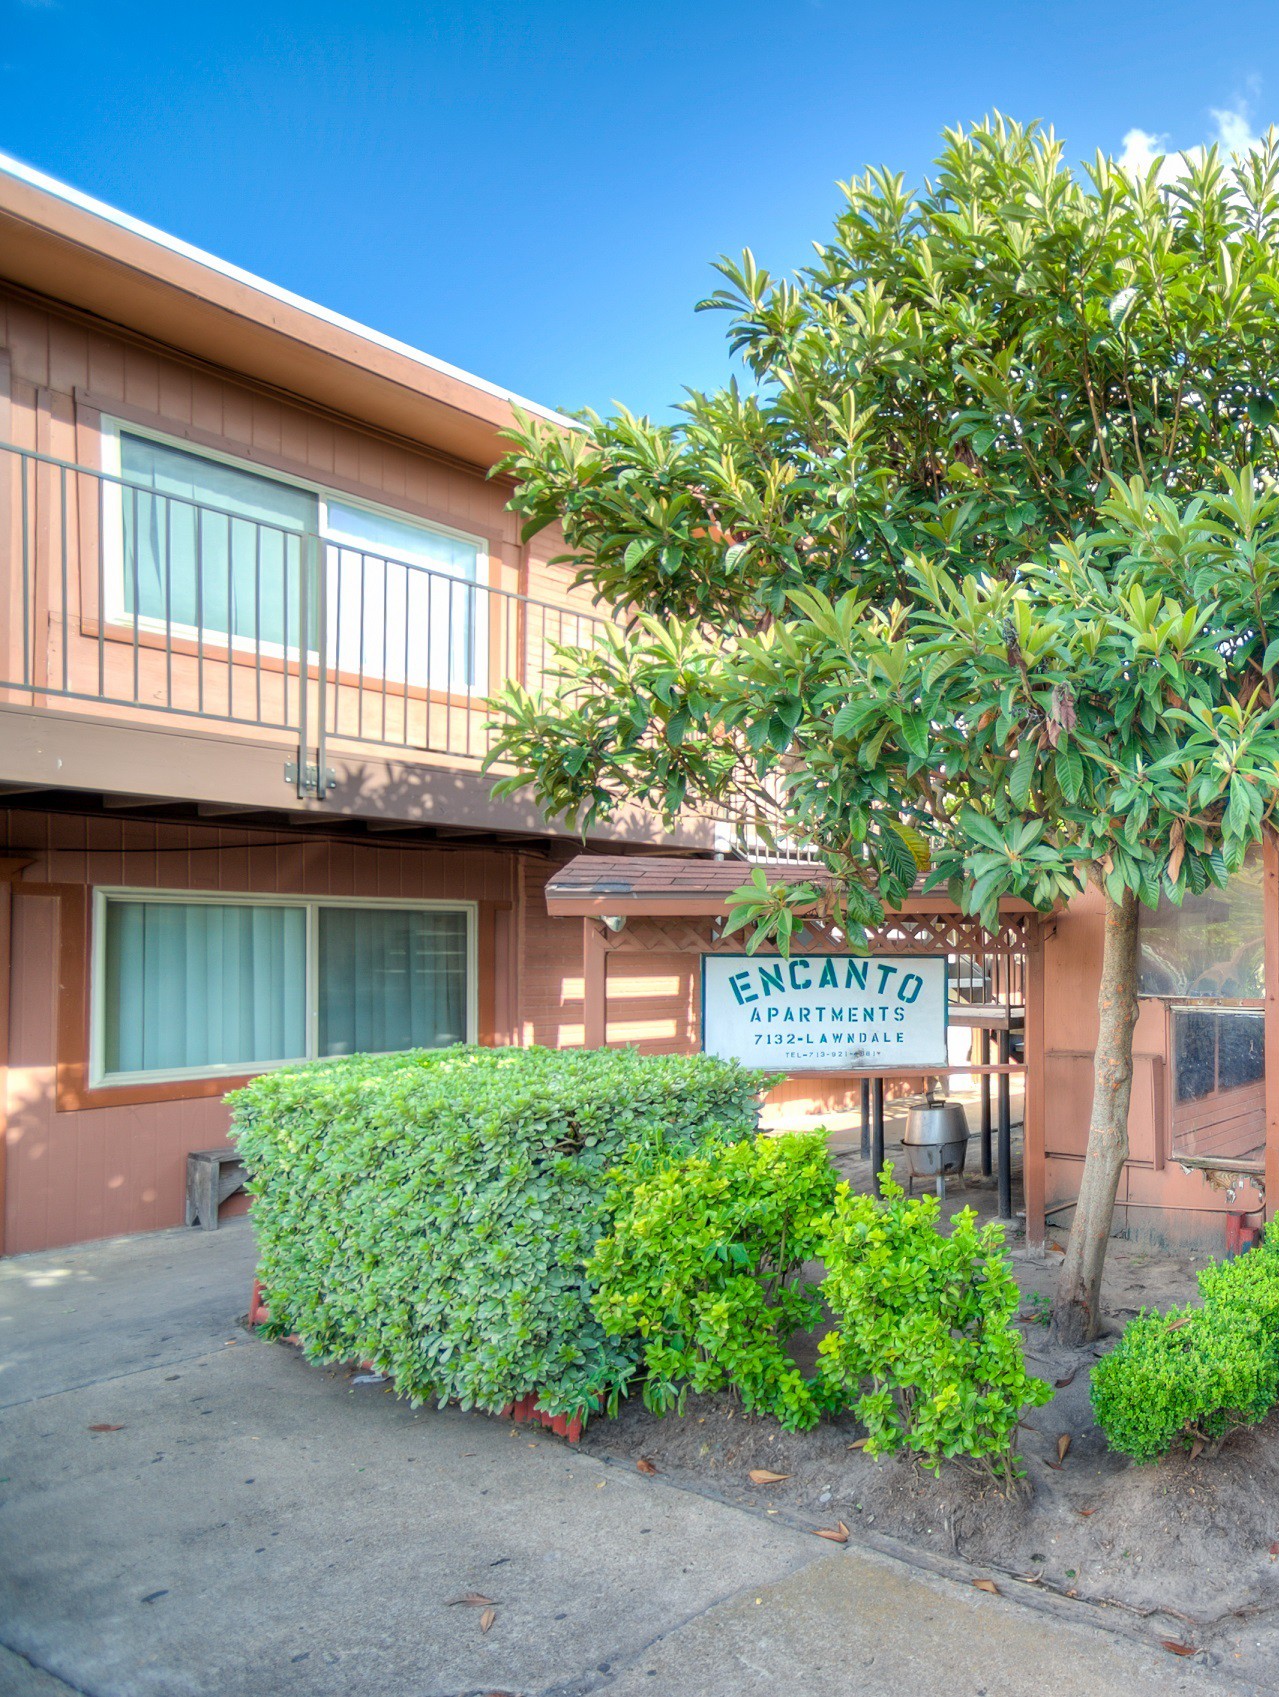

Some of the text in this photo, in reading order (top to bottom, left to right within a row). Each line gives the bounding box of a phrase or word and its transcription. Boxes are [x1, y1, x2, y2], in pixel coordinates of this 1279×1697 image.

[728, 957, 924, 1005] ENCANTO
[750, 1006, 905, 1022] APARTMENTS
[754, 1032, 904, 1045] 7132-LAWNDALE
